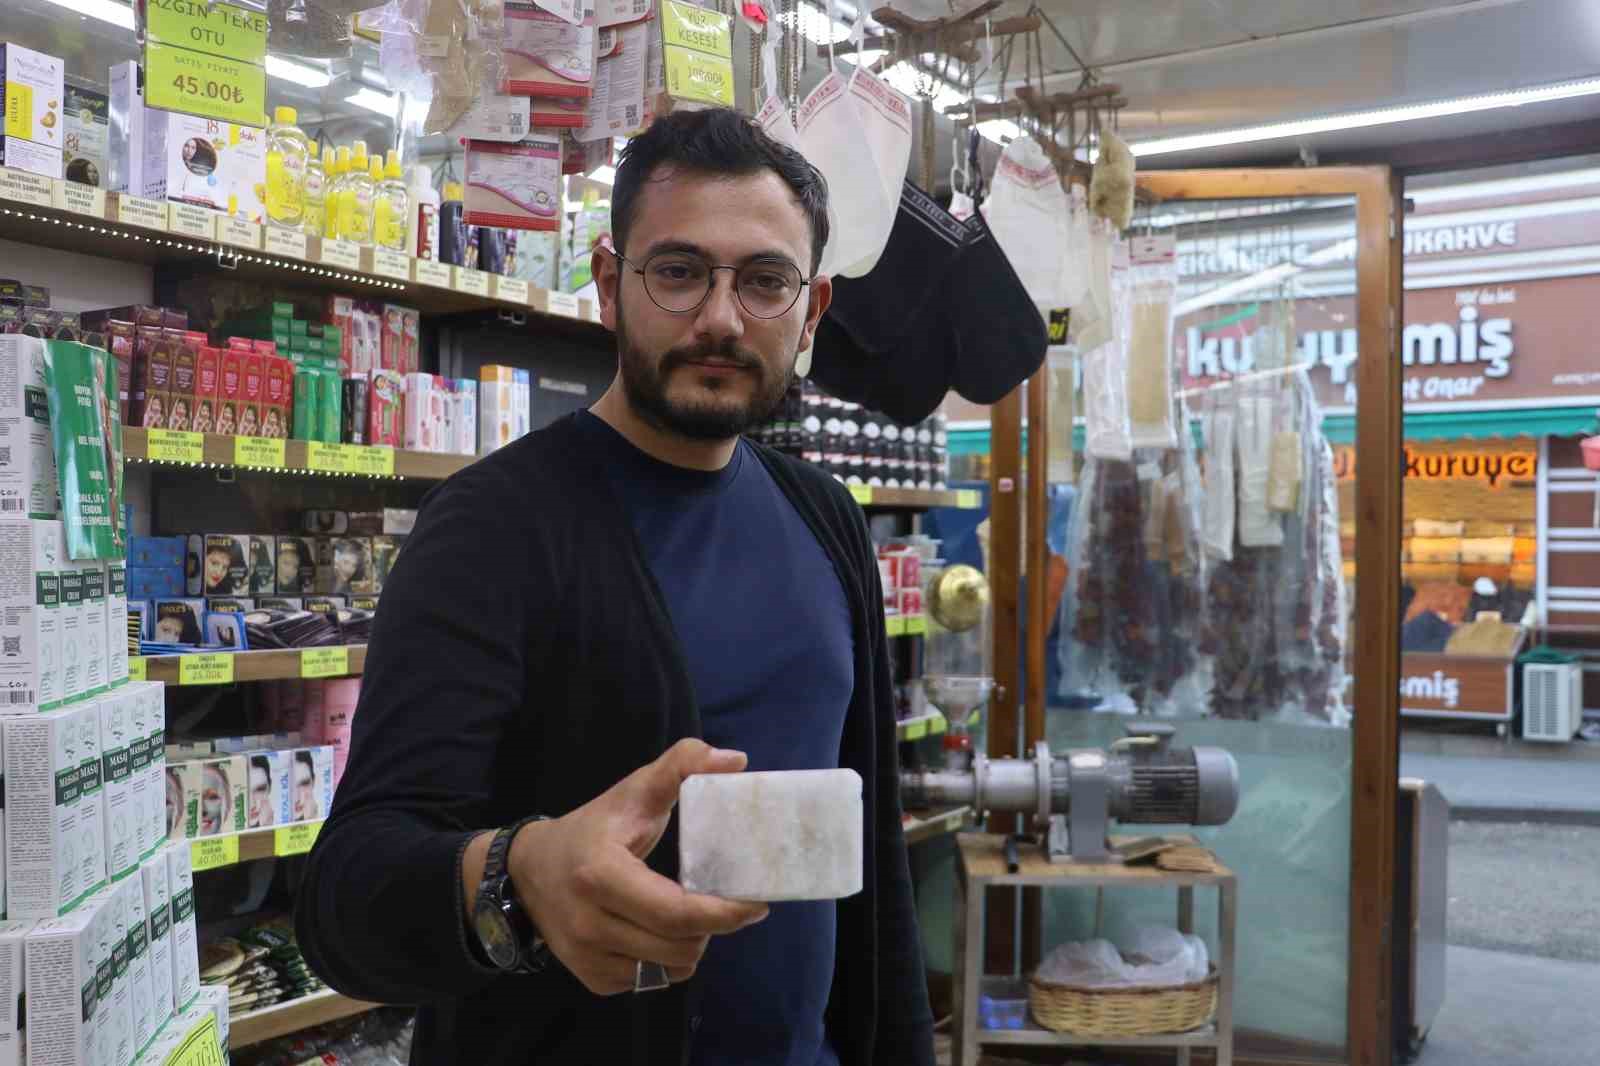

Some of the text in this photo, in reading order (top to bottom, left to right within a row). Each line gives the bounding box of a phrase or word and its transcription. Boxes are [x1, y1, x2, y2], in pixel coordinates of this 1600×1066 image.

[190, 26, 225, 46] OTU
[173, 74, 245, 104] 45.00₺
[1403, 447, 1538, 487] kuruye
